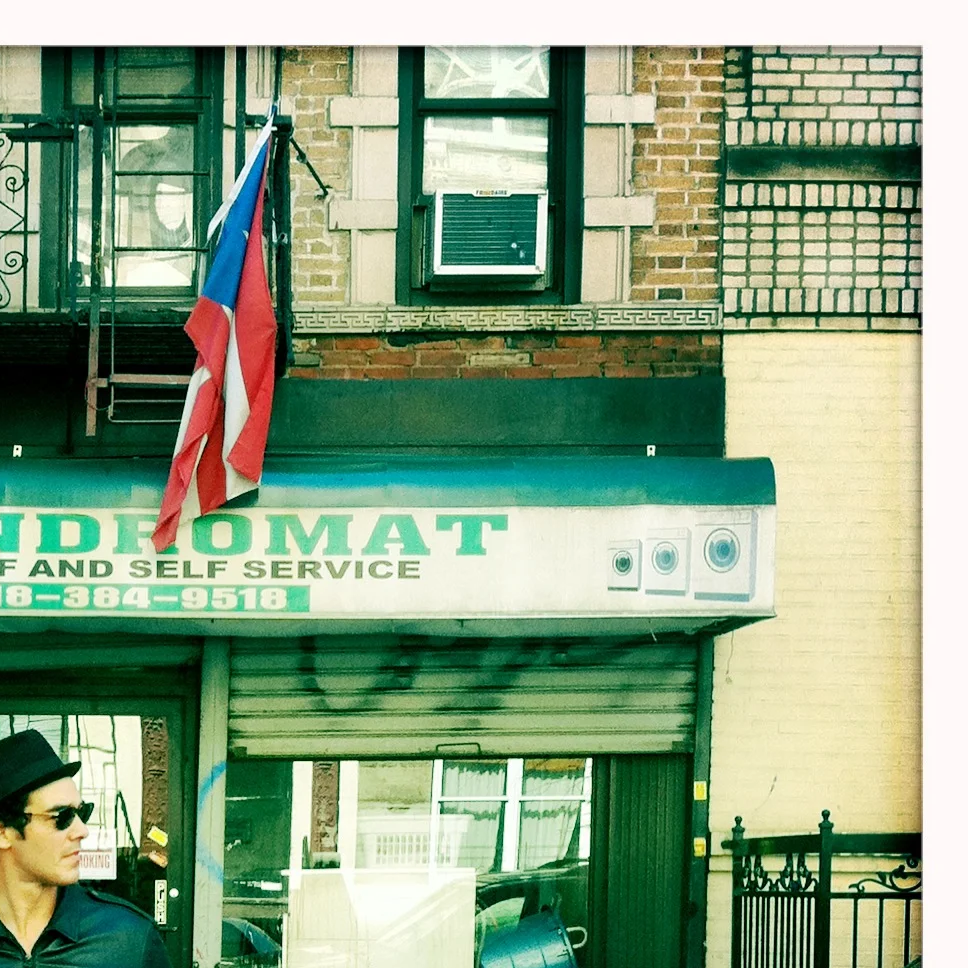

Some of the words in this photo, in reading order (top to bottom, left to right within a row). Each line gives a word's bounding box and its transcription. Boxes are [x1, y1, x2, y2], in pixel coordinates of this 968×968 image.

[28, 559, 114, 578] AND
[128, 560, 229, 579] SELF
[243, 560, 421, 580] SERVICE
